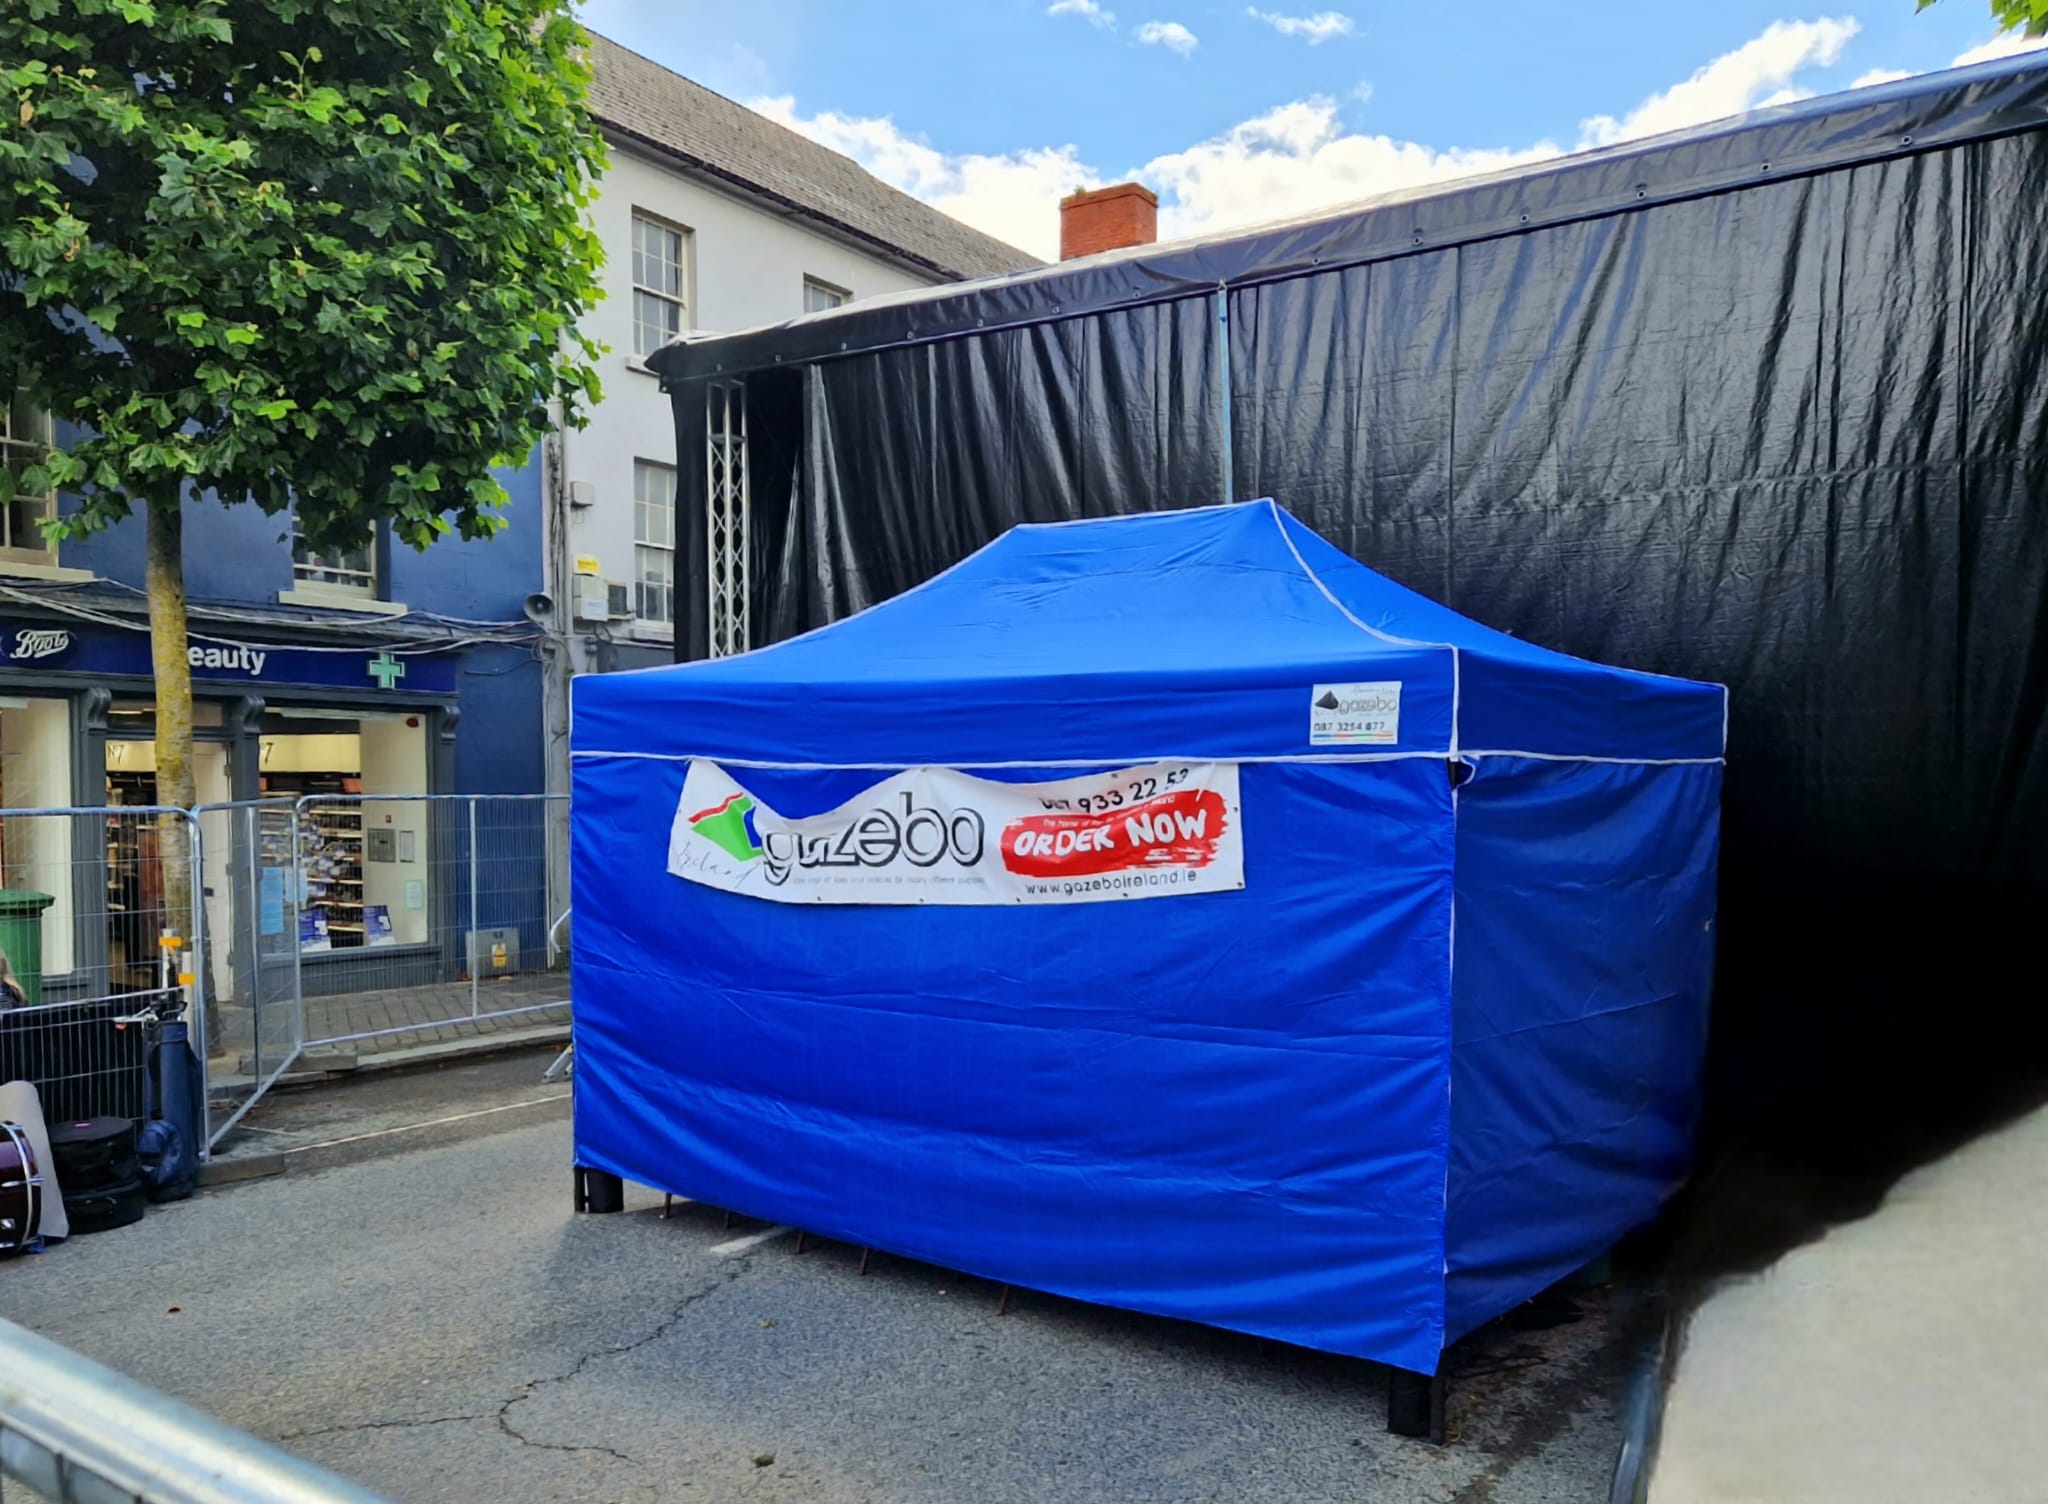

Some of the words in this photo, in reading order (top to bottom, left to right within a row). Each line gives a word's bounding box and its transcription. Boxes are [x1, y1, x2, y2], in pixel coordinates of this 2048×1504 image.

[9, 629, 69, 658] Boots
[189, 646, 266, 675] eauty
[1338, 696, 1397, 714] gazebo
[1078, 790, 1123, 813] 933
[1129, 778, 1157, 801] 22
[1014, 825, 1114, 857] ORDER
[1125, 808, 1208, 847] NOW
